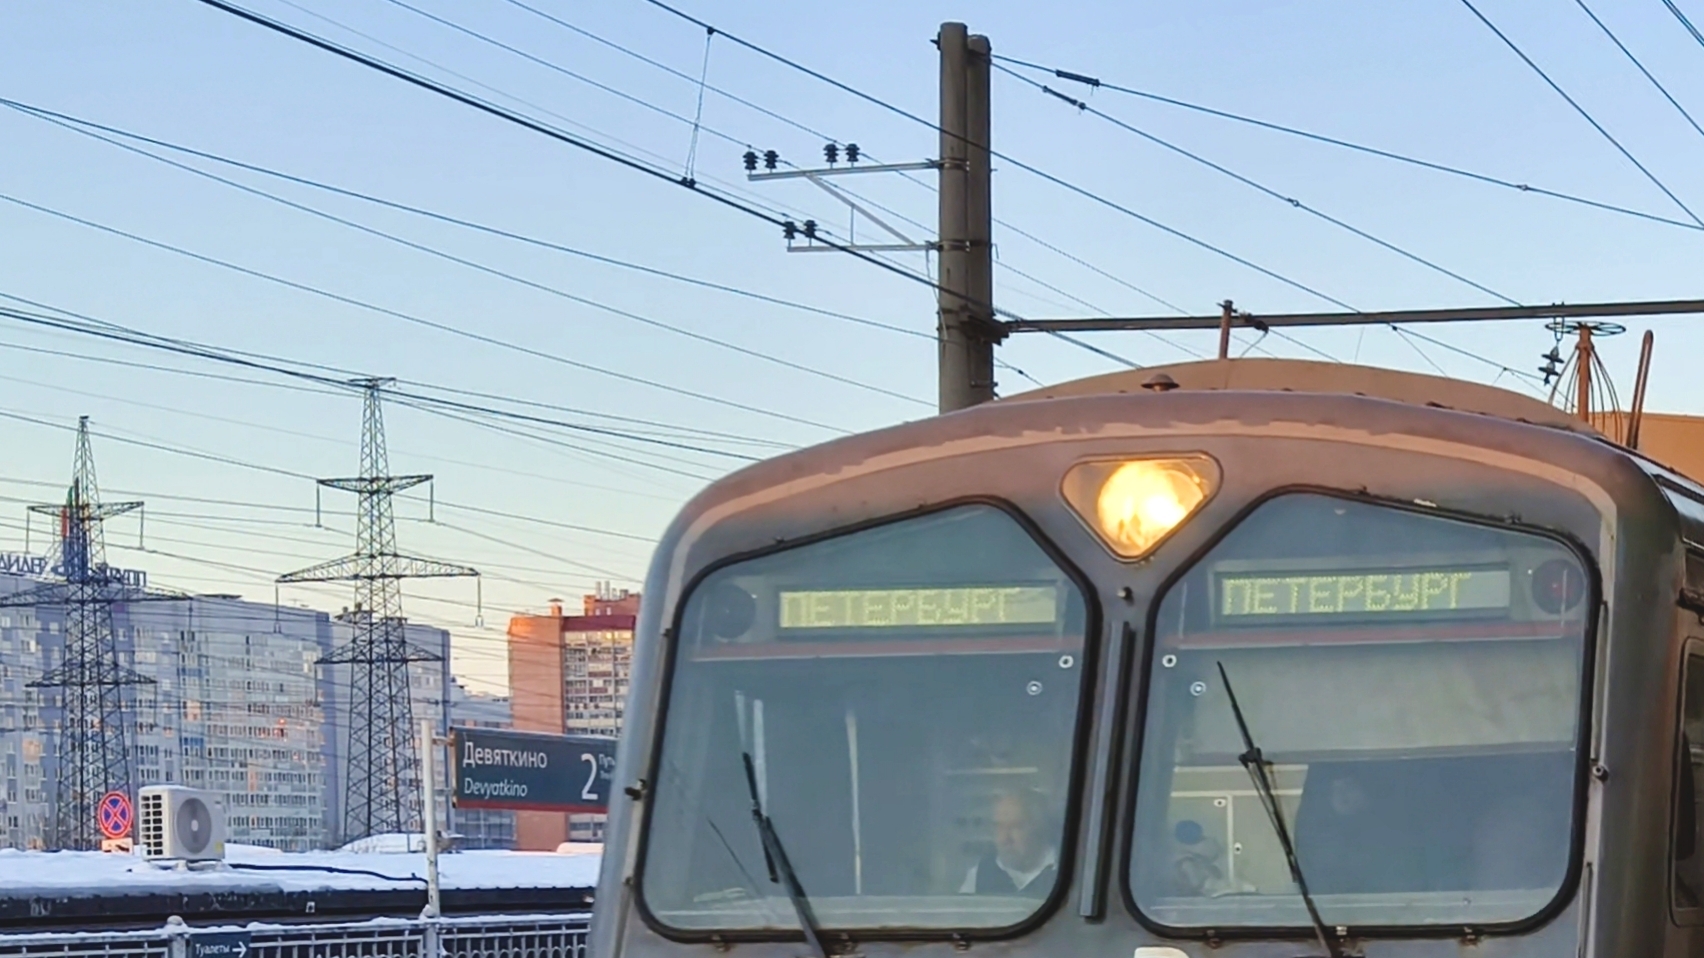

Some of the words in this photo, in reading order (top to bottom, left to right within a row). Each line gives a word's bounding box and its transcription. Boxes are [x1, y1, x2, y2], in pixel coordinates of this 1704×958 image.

[780, 587, 1021, 628] ПЕТЕРБУРГ
[1222, 572, 1472, 615] ПЕТЕРБУРГ
[463, 741, 548, 769] Девяткино
[464, 777, 528, 799] Devyatkino
[581, 753, 599, 801] 2
[195, 943, 230, 958] Туалеты
